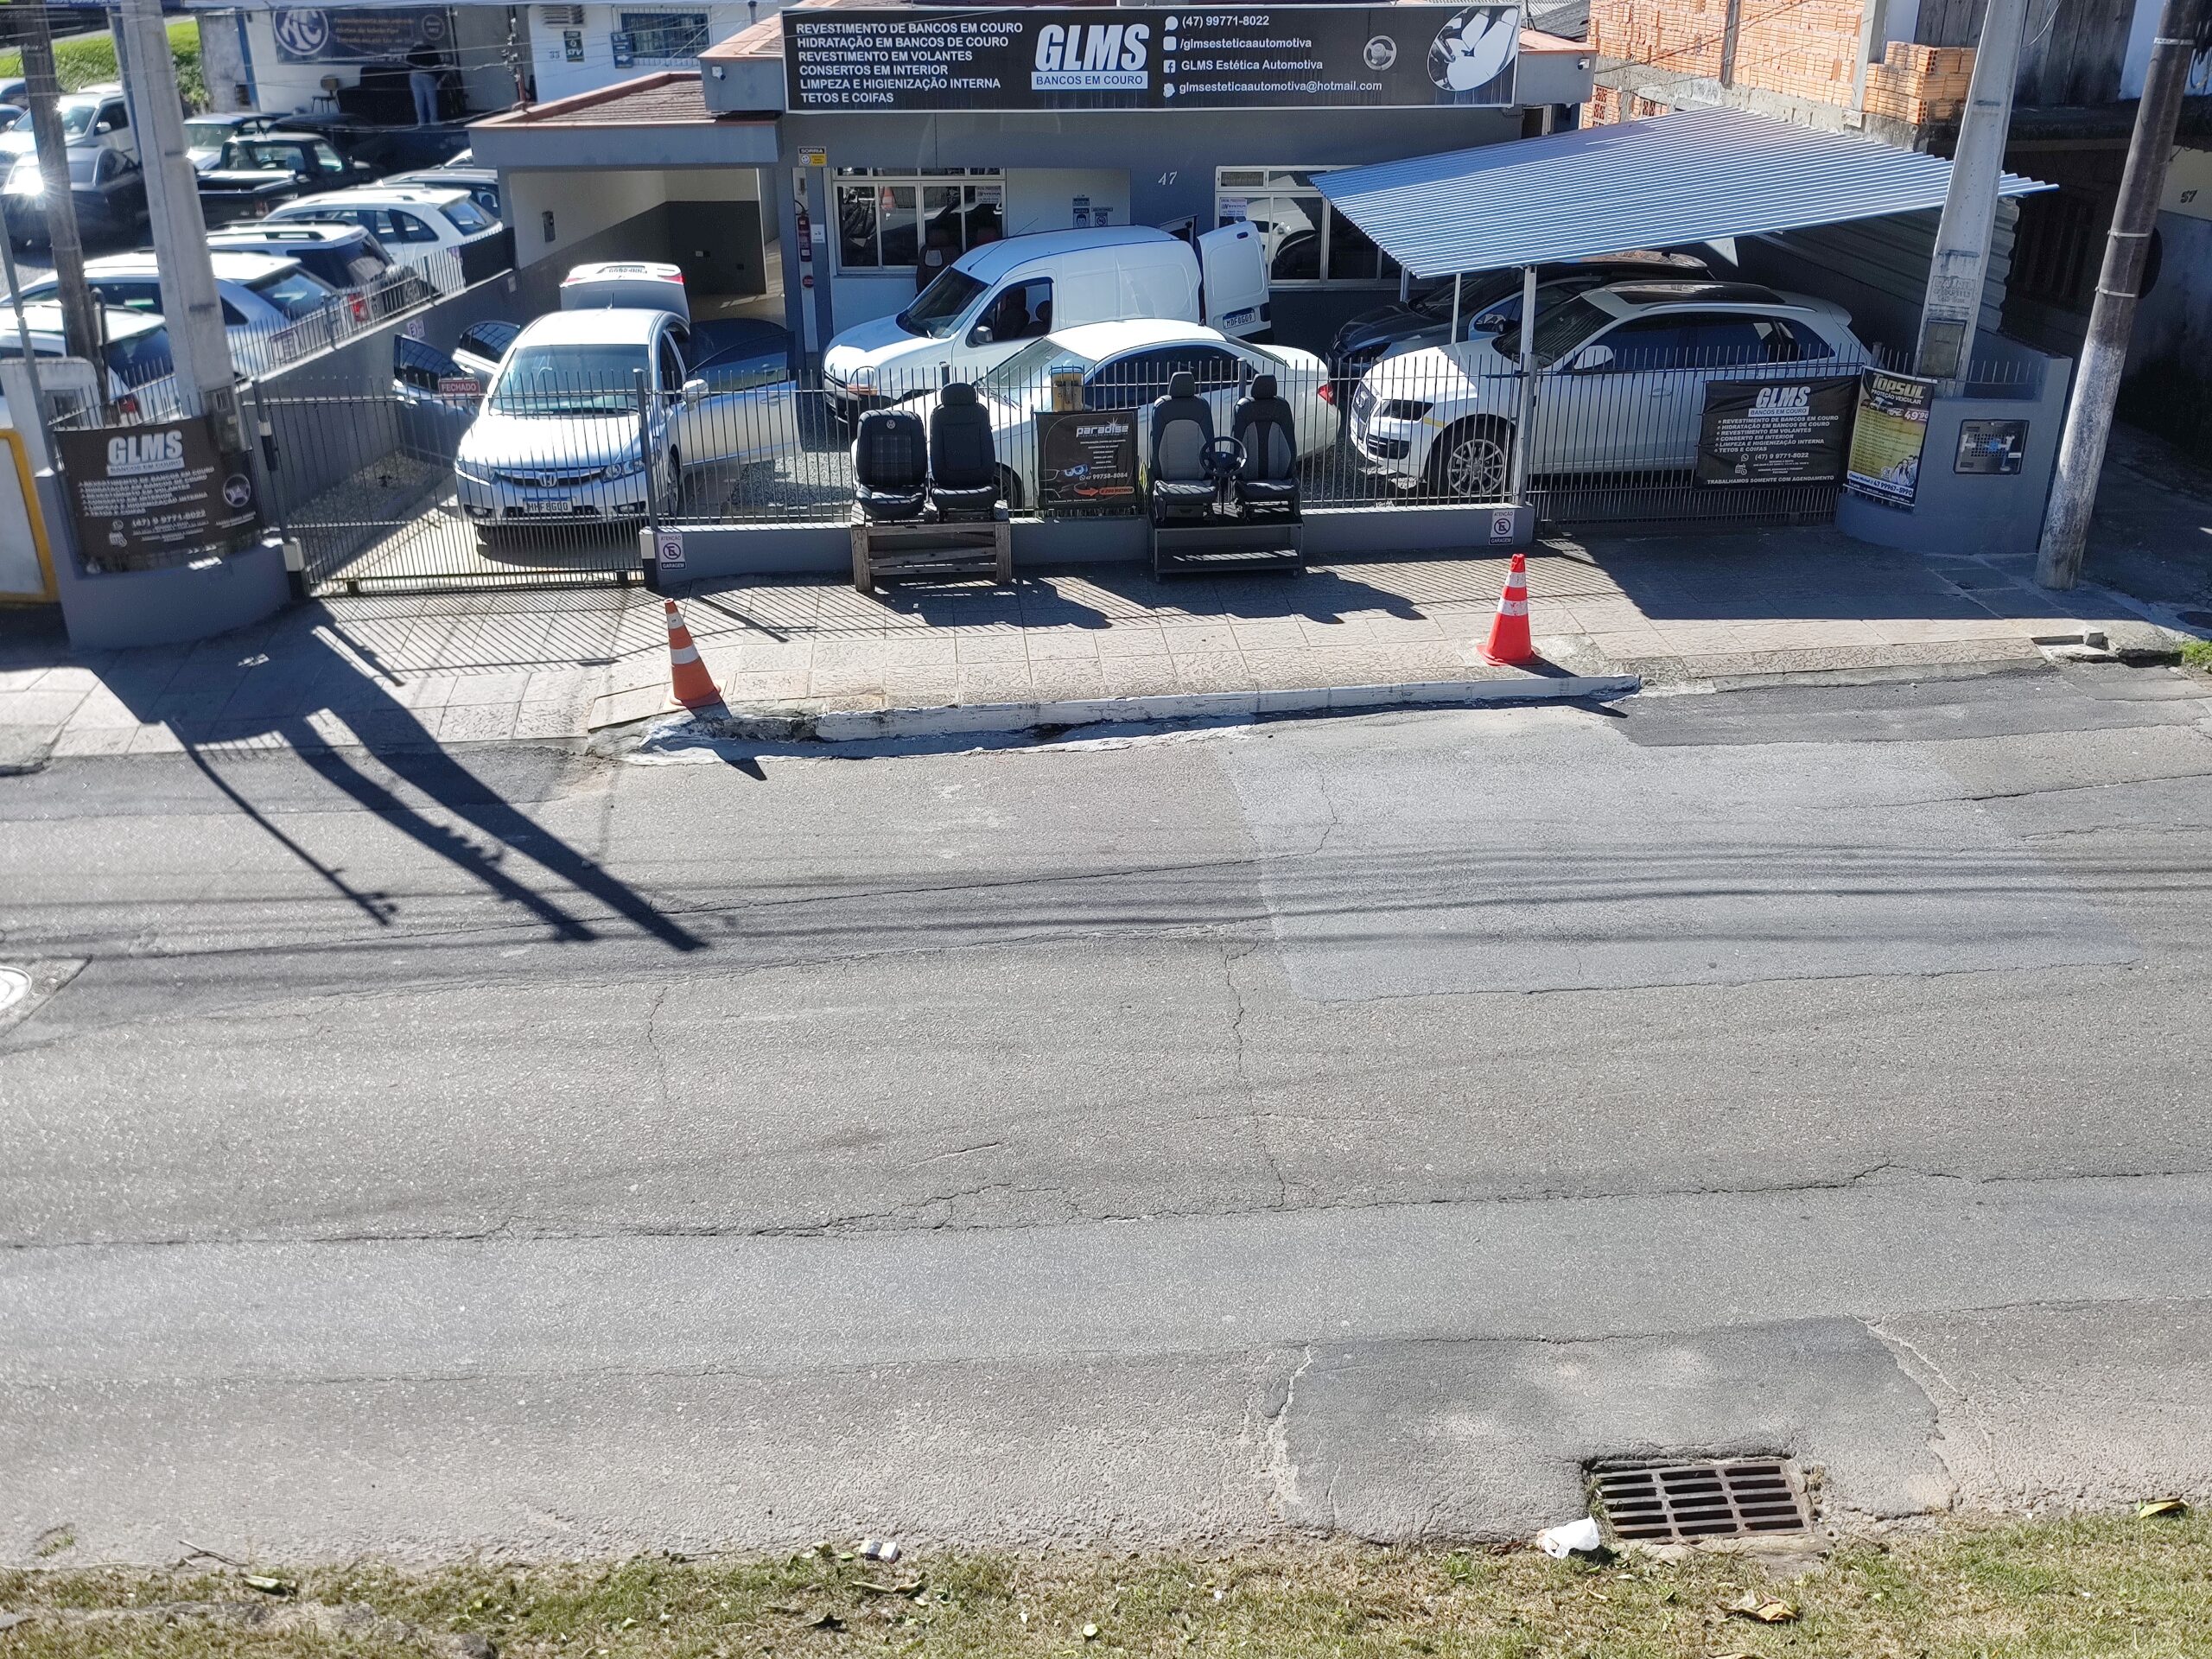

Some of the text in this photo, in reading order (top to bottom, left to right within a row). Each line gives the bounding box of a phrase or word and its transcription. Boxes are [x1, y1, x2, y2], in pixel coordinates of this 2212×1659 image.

[796, 22, 1022, 35] REVESTIMENTO DE BANCOS EM COURO
[1182, 16, 1269, 29] (47) 99771-8022
[797, 35, 1009, 49] HIDRATAÇÃO EM BANCOS DE COURO
[1034, 23, 1149, 71] GLMS
[1180, 38, 1312, 50] /glmsesteticaautomotiva
[798, 50, 973, 61] REVESTIMENTO EM VOLANTES
[799, 65, 948, 75] CONSERTOS EM INTERIOR
[1181, 60, 1323, 70] GLMS Estética Automotiva
[800, 76, 1001, 92] LIMPEZA E HIGIENIZAÇÃO INTERNA
[1036, 75, 1143, 86] BANCOS EM COURO
[1179, 80, 1382, 94] glmsesteticaautomotiva@hotmail.com
[801, 92, 893, 103] TETOS E COIFAS
[1158, 171, 1178, 185] 47
[2180, 189, 2198, 203] 57
[442, 383, 476, 392] FECHADO
[1872, 372, 1924, 399] TOPSUL
[1756, 386, 1811, 408] GLMS
[1871, 388, 1922, 405] PROTEÇÃO VEICULAR
[1076, 423, 1129, 438] paradise
[107, 429, 183, 466] GLMS
